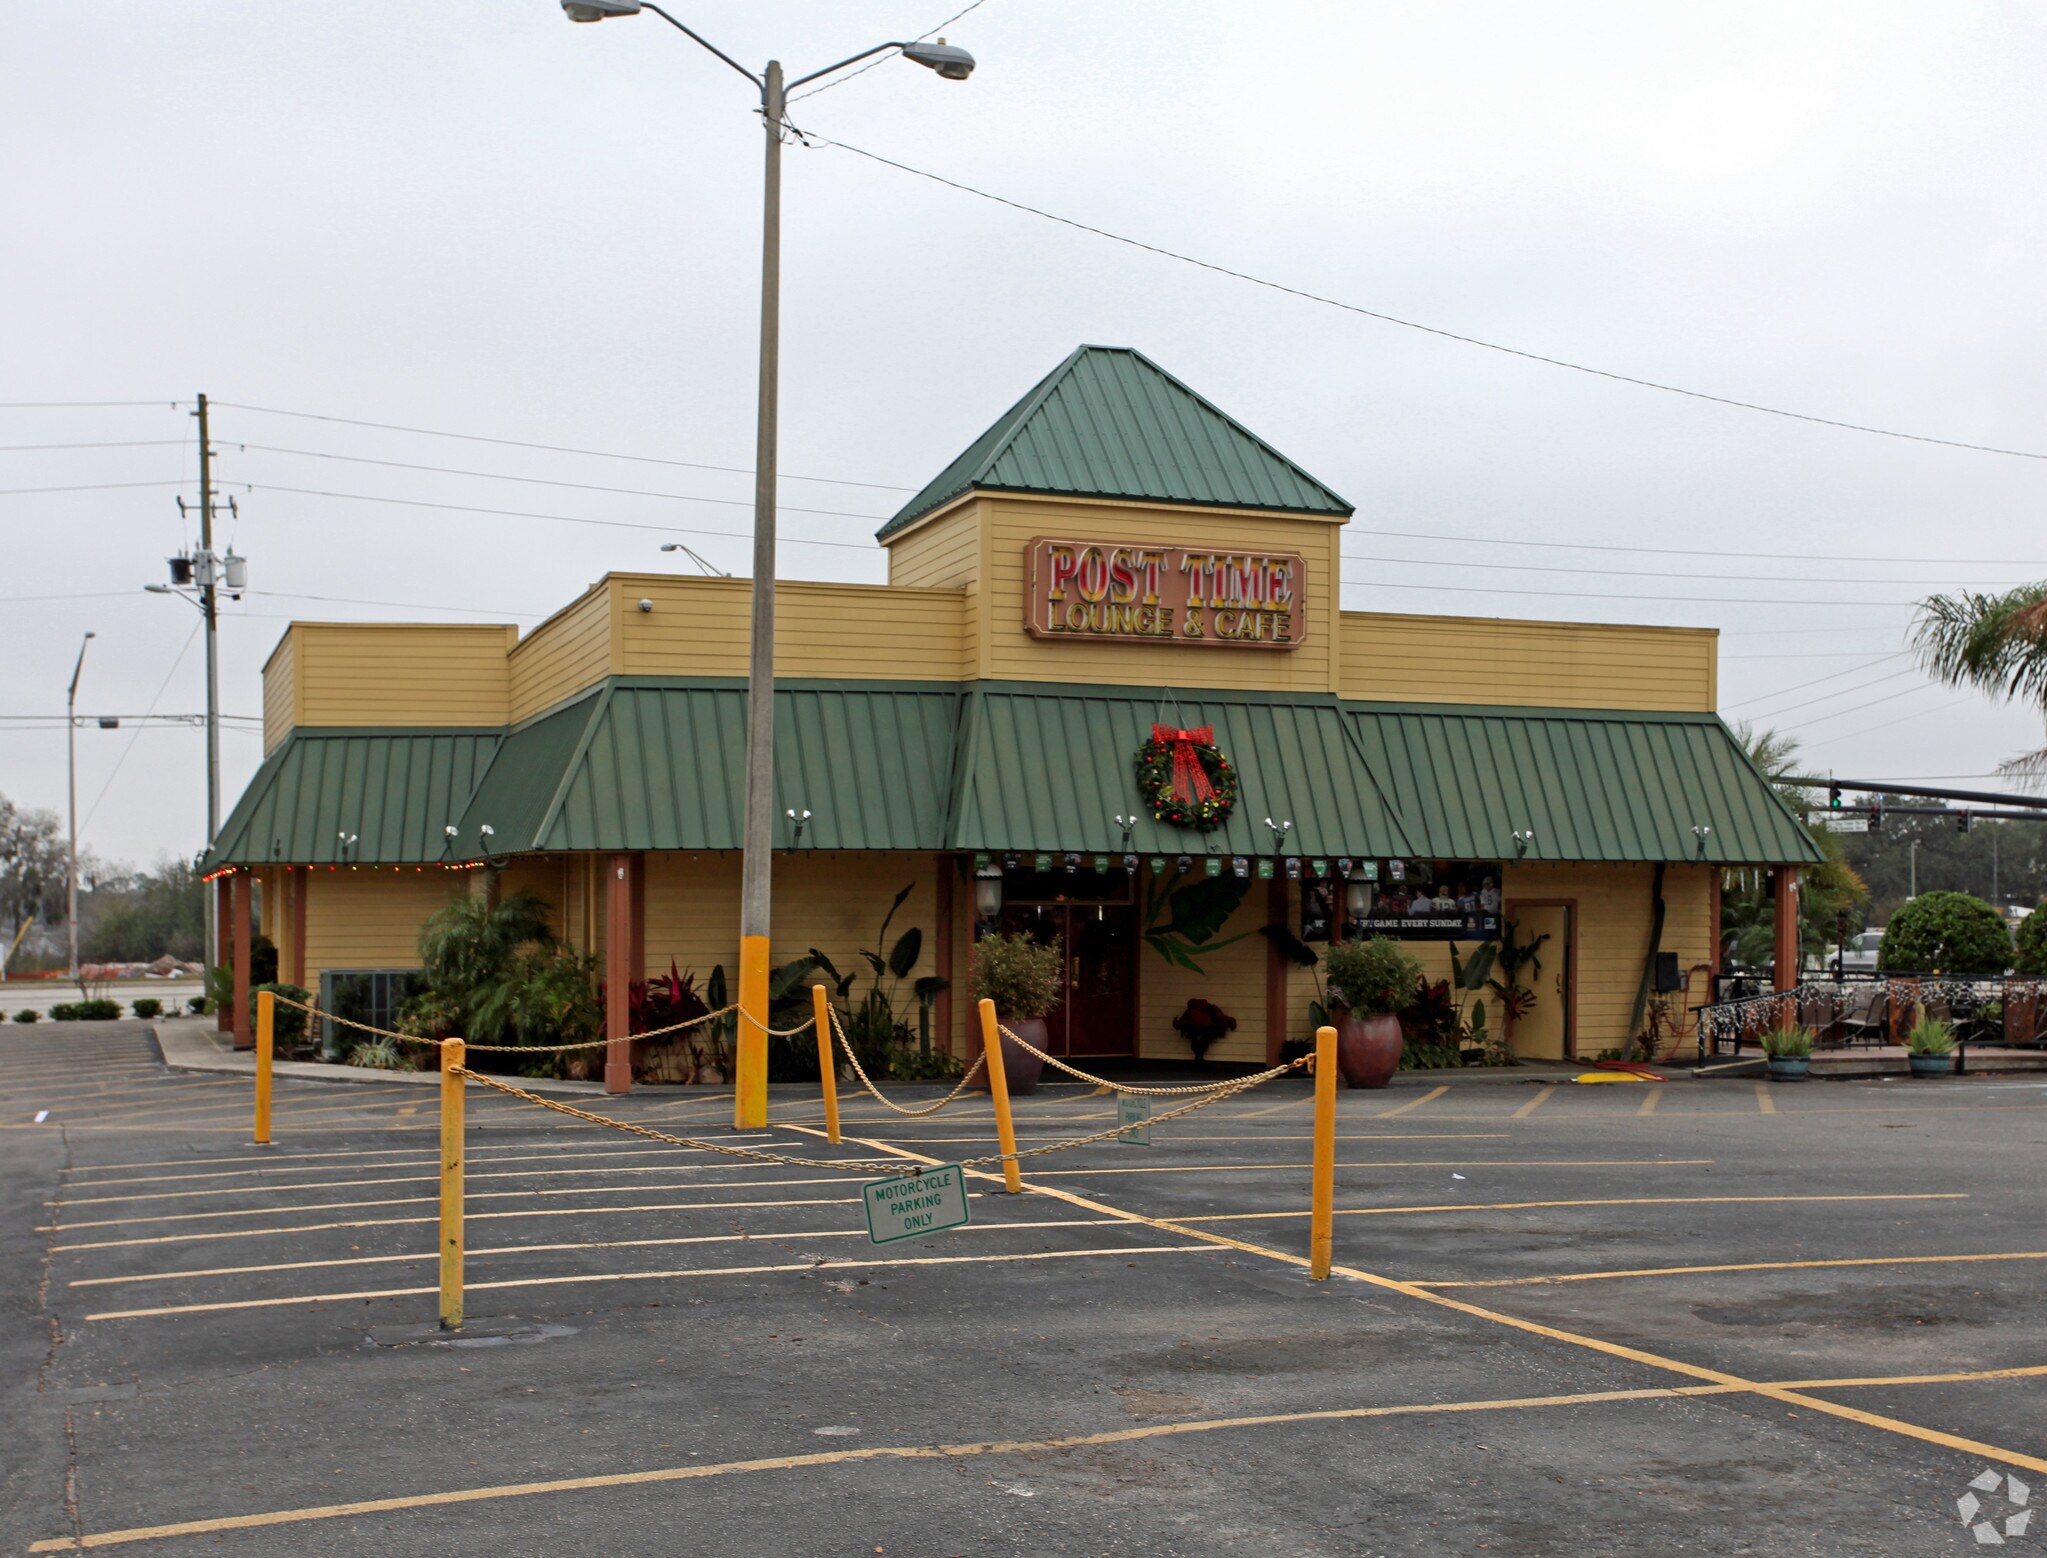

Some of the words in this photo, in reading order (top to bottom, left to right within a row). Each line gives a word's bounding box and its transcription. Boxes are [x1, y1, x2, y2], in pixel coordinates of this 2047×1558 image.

[1048, 545, 1169, 606] POST
[1180, 553, 1294, 613] TIME
[1048, 601, 1175, 638] LOUNGE
[1182, 609, 1205, 639] &
[1214, 610, 1292, 642] CAFE
[1401, 919, 1429, 928] EVERY
[875, 1173, 952, 1202] MOTORCYCLE
[890, 1193, 942, 1216] PARKING
[904, 1212, 933, 1230] ONLY
